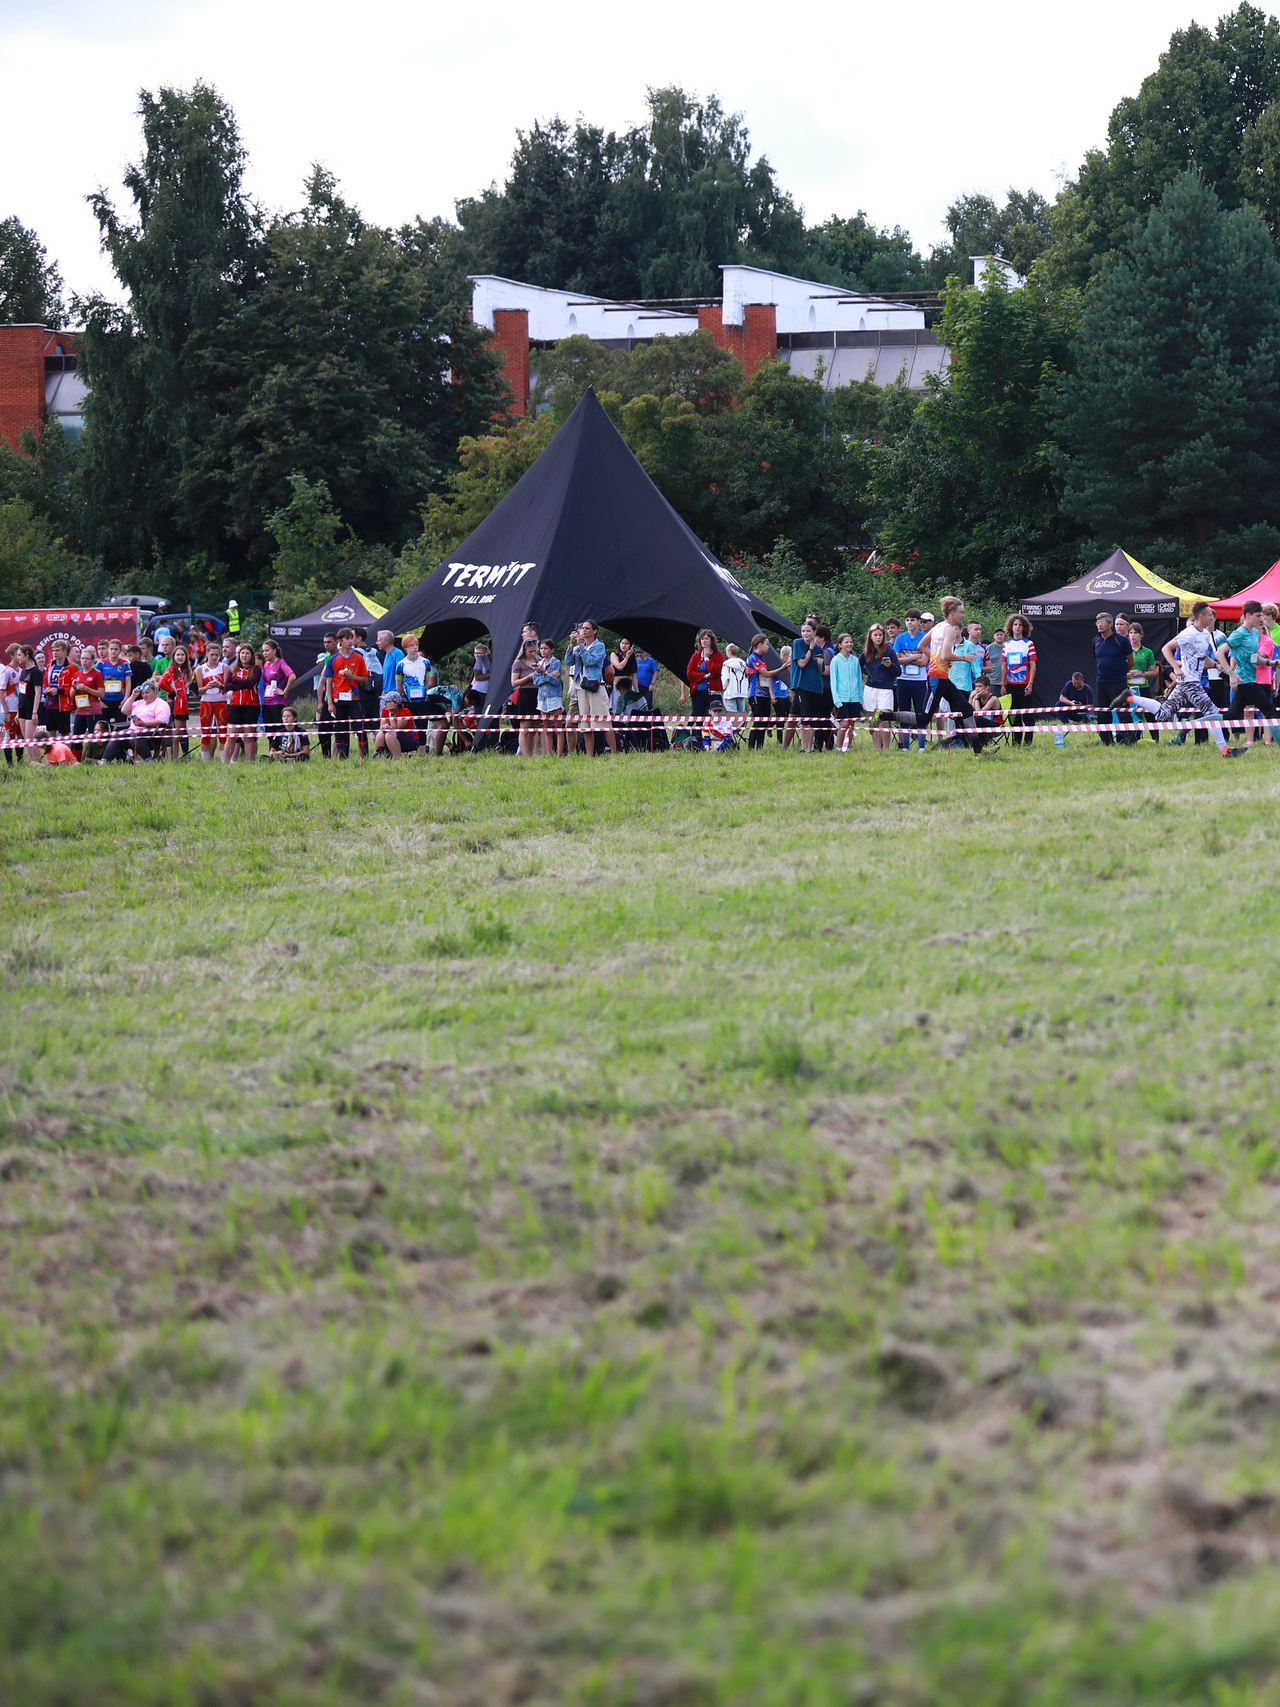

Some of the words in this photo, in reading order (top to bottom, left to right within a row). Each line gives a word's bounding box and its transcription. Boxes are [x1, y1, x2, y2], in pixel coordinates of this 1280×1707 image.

[441, 561, 537, 589] TERMIT
[465, 595, 480, 604] ALL
[36, 632, 70, 651] ВЕНСТВО
